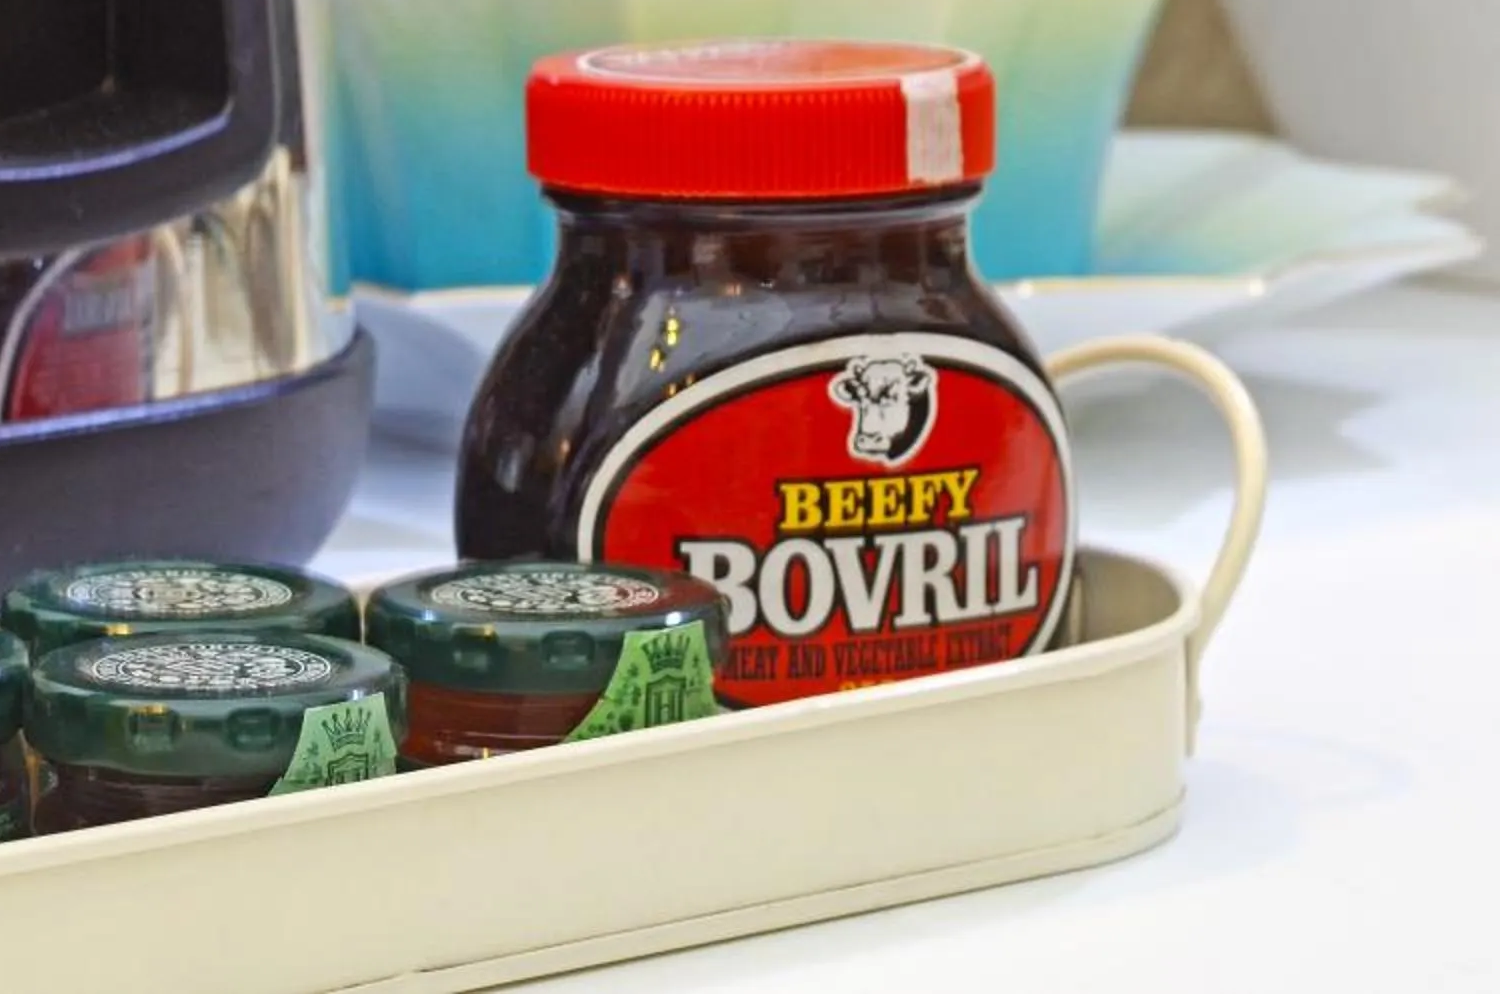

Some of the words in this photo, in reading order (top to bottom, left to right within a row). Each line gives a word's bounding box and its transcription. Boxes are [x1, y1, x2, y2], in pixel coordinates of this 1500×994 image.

[780, 470, 978, 530] BEEFY
[680, 516, 1039, 637] BOVRIL
[786, 642, 826, 679] AND
